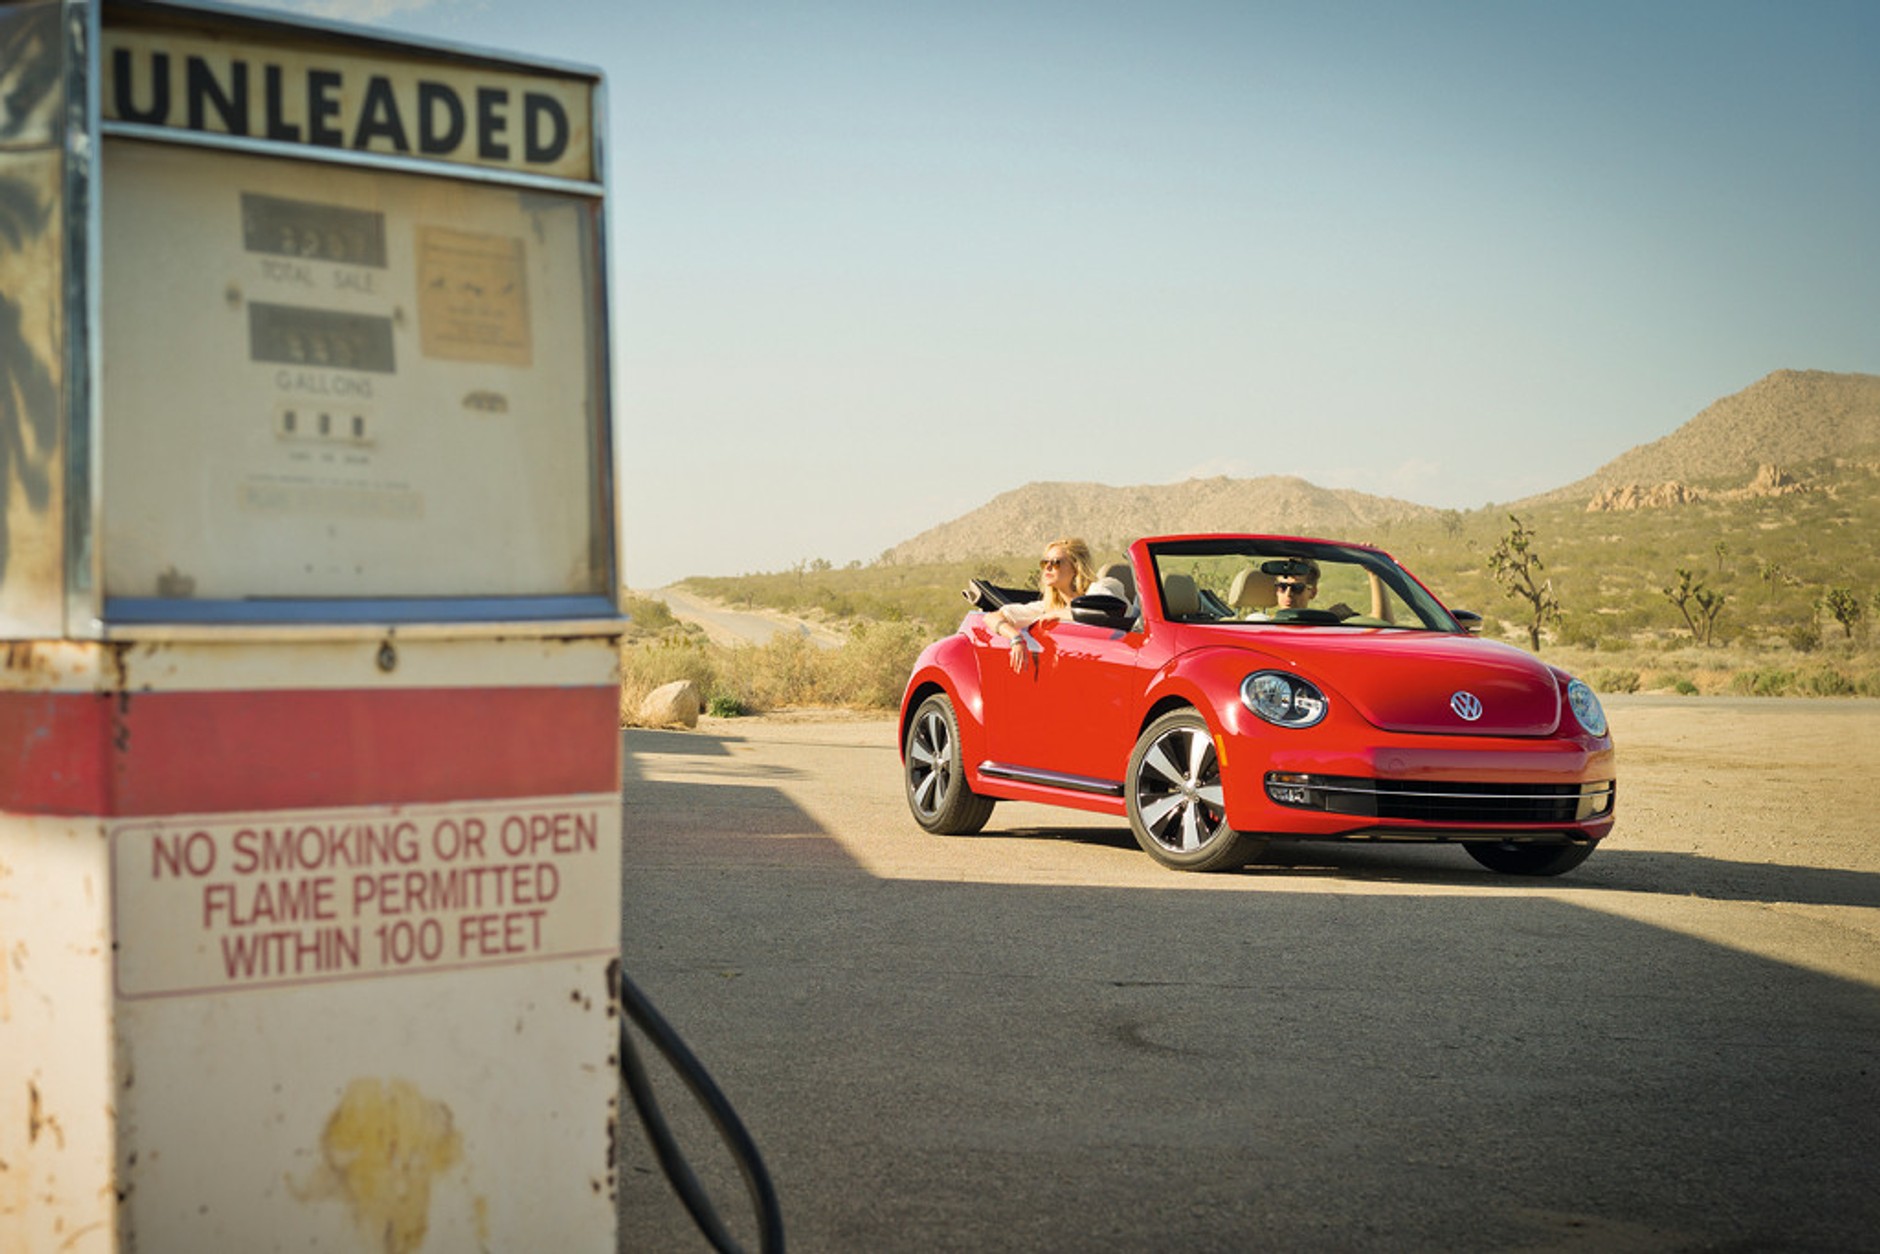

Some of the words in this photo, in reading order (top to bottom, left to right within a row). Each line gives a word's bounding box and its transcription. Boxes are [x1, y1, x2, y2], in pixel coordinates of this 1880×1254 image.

[111, 47, 570, 164] UNLEADED
[333, 269, 375, 294] SALE
[275, 370, 374, 398] GALLONS
[1450, 691, 1483, 721] VW
[152, 831, 217, 880] NO
[231, 819, 420, 876] SMOKING
[432, 817, 487, 862] OR
[500, 812, 599, 857] OPEN
[203, 877, 336, 929] FLAME
[353, 862, 560, 916] PERMITTED
[221, 927, 361, 980] WITHIN
[375, 918, 443, 965] 100
[459, 910, 547, 957] FEET
